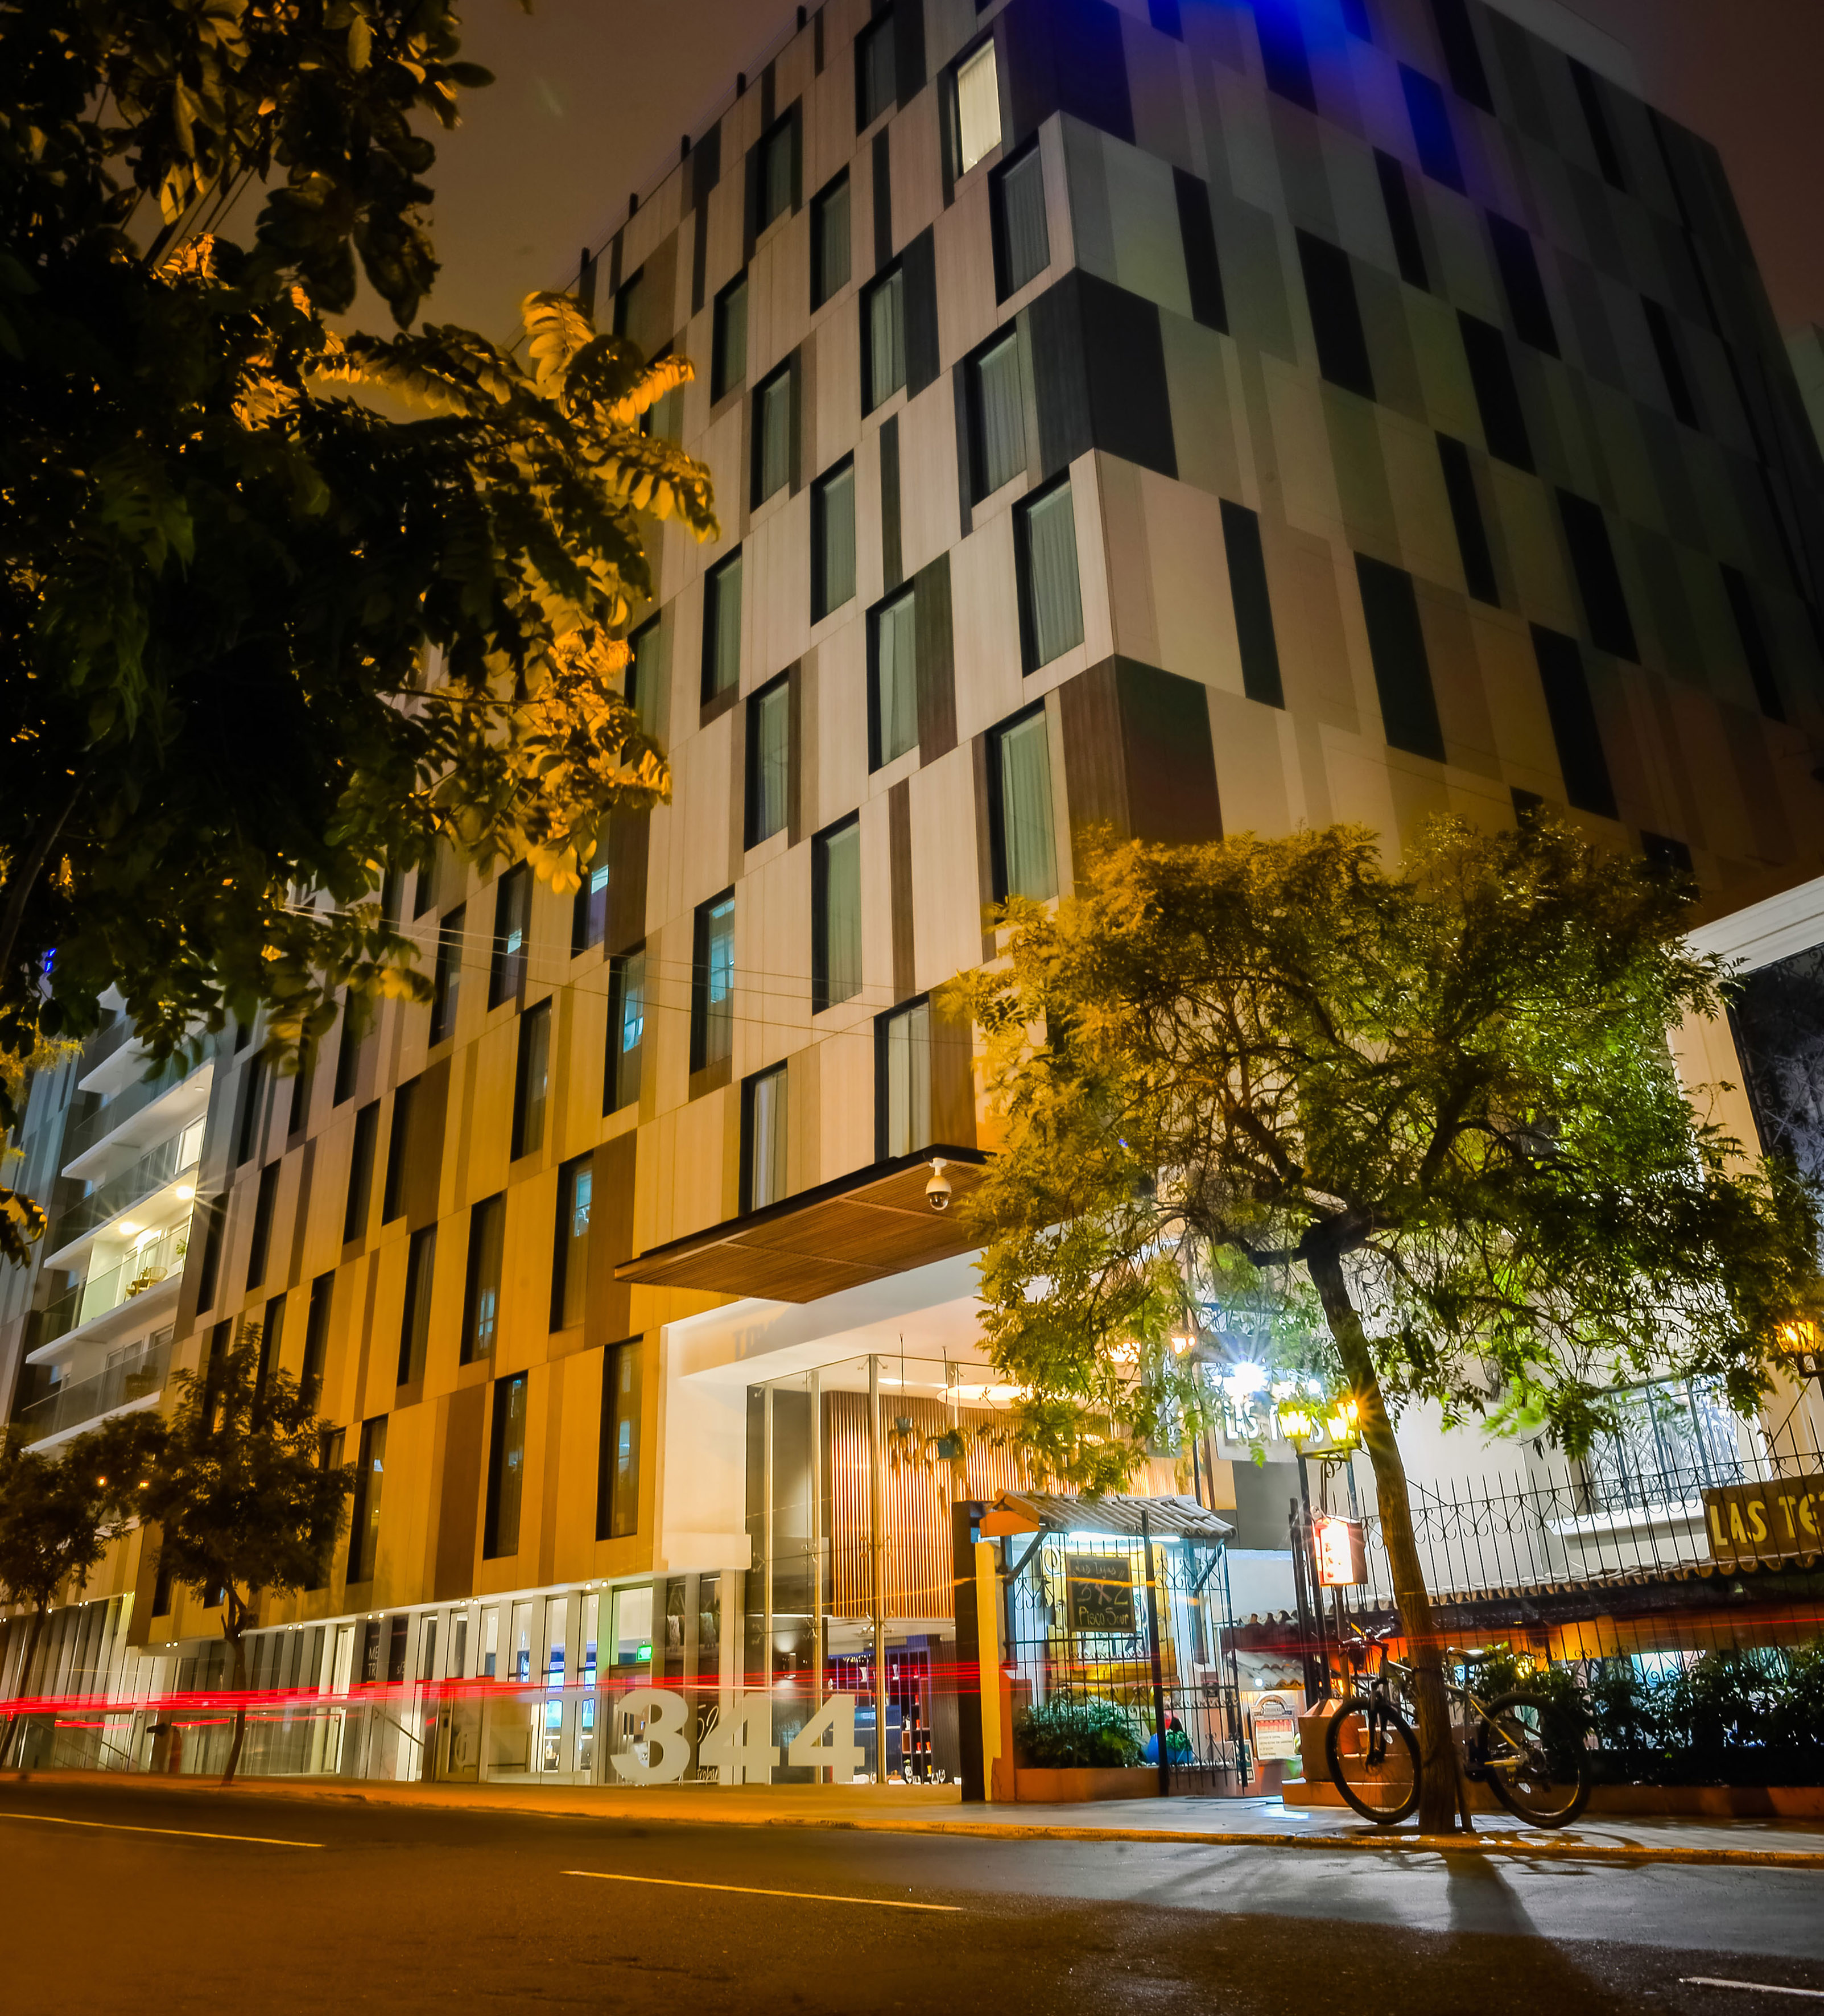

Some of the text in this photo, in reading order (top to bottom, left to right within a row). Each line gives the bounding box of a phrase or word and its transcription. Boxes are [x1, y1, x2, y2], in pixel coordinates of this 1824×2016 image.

[1709, 1491, 1824, 1546] LAS TE
[1079, 1606, 1129, 1626] Pisco Sour
[610, 1688, 865, 1785] 344
